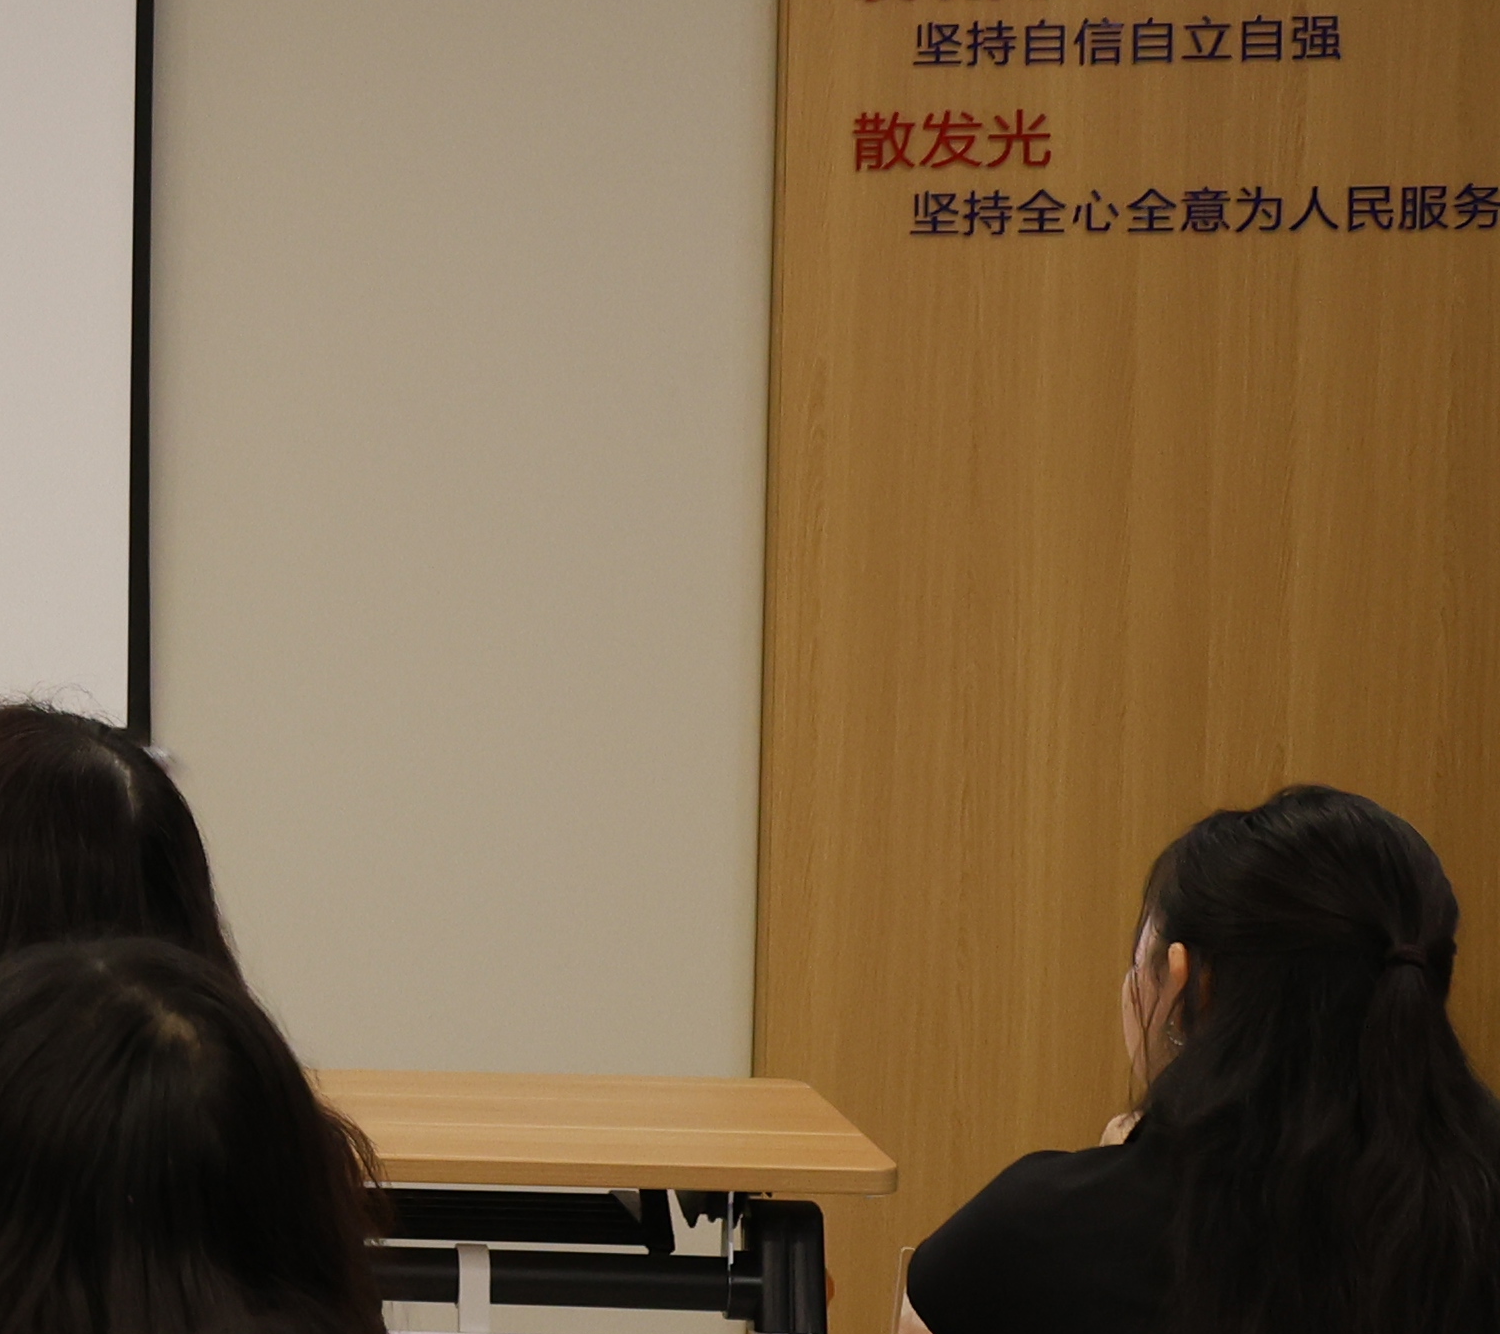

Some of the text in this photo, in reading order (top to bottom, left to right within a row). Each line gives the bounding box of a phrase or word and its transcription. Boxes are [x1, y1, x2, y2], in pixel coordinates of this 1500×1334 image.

[913, 14, 1342, 67] 坚持自信自立自强
[852, 108, 1052, 172] 散发光
[909, 182, 1500, 236] 坚持全心全意为人民服务
